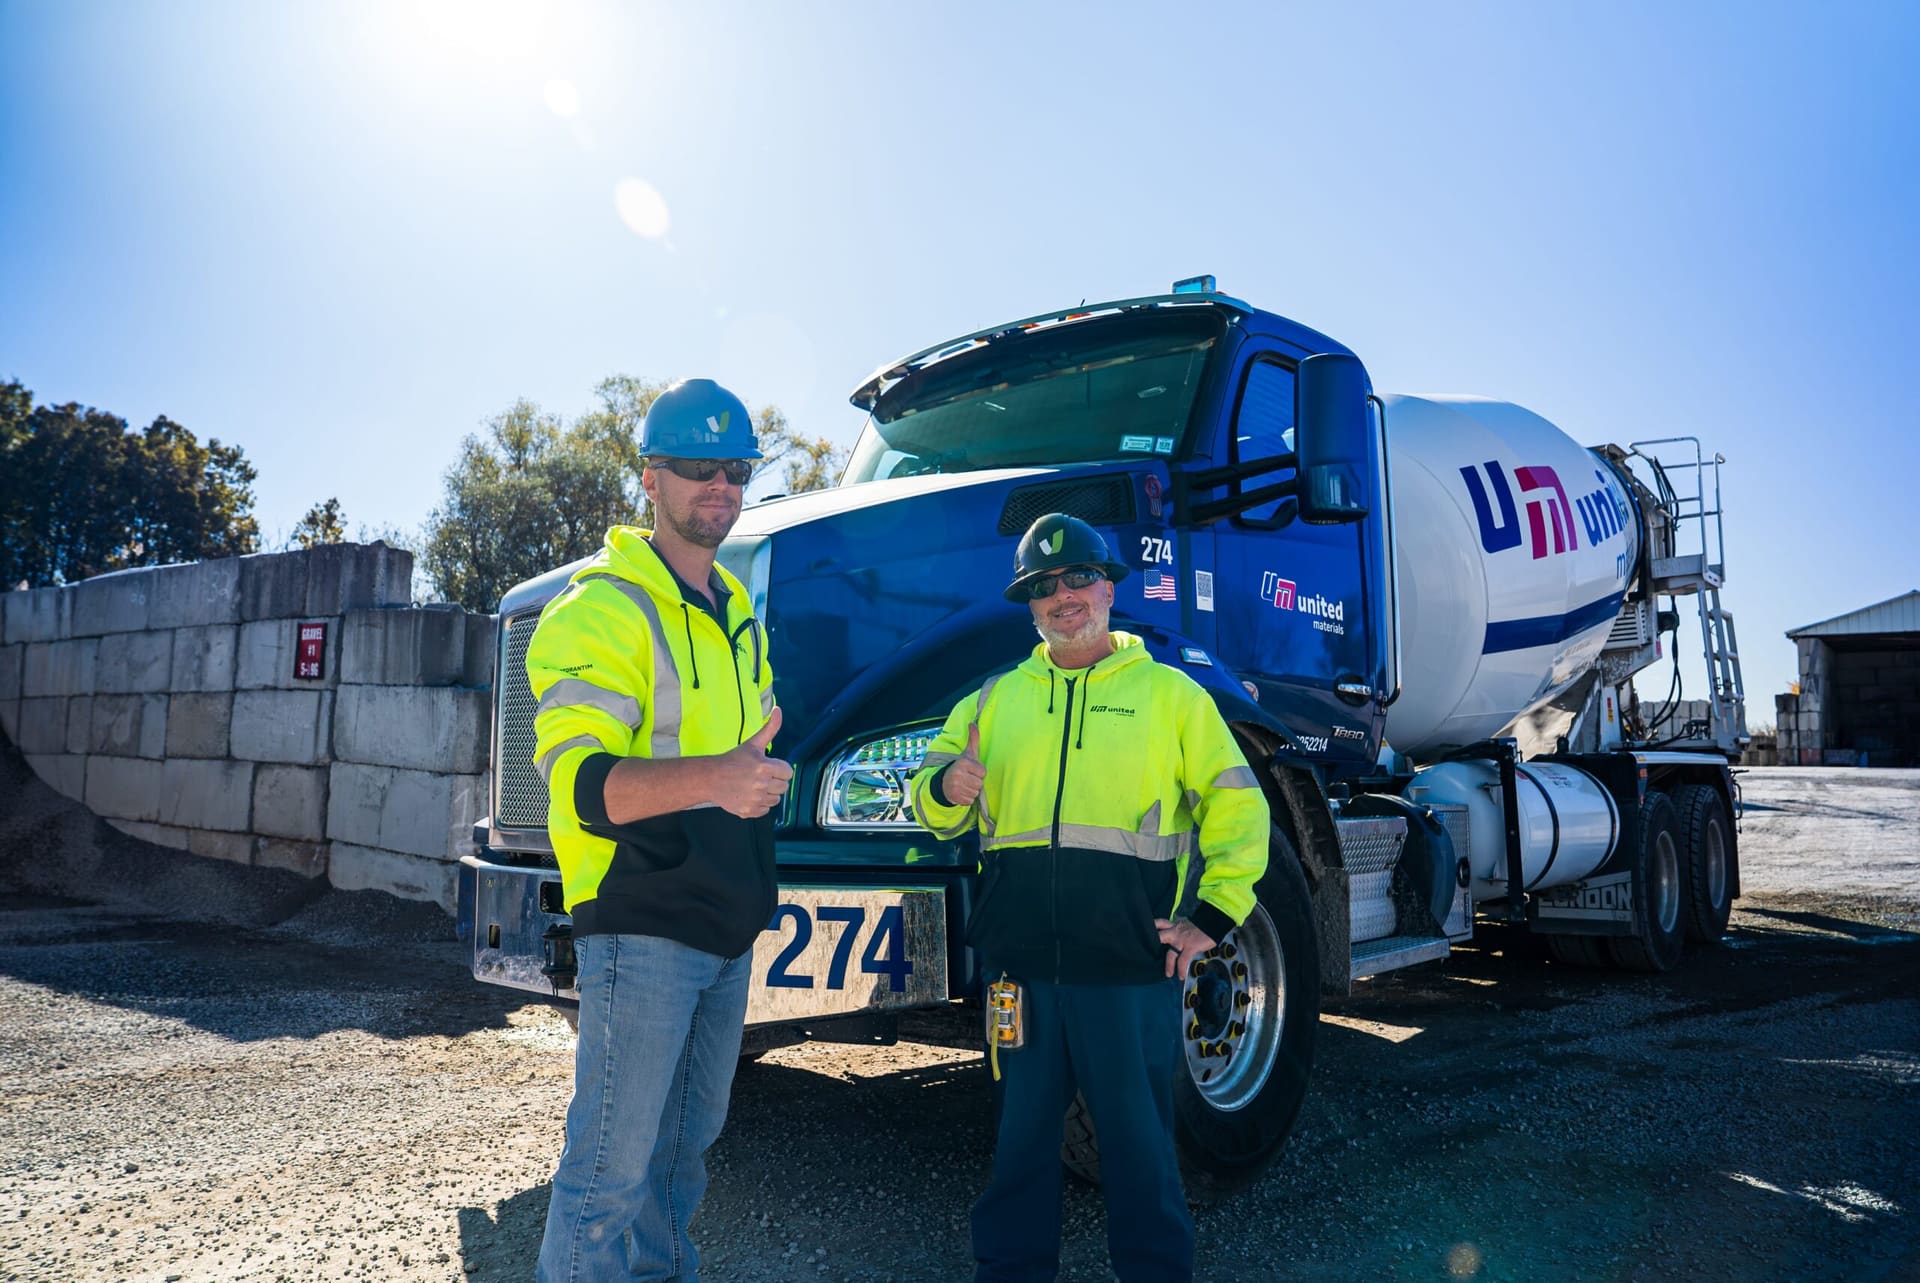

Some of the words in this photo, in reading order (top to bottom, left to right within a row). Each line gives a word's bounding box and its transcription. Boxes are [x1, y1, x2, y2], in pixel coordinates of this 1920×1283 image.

[1141, 536, 1173, 565] 274
[1297, 593, 1344, 622] united
[1312, 620, 1344, 636] materials
[1107, 706, 1135, 715] united
[1332, 725, 1365, 740] T880
[766, 903, 914, 993] 274
